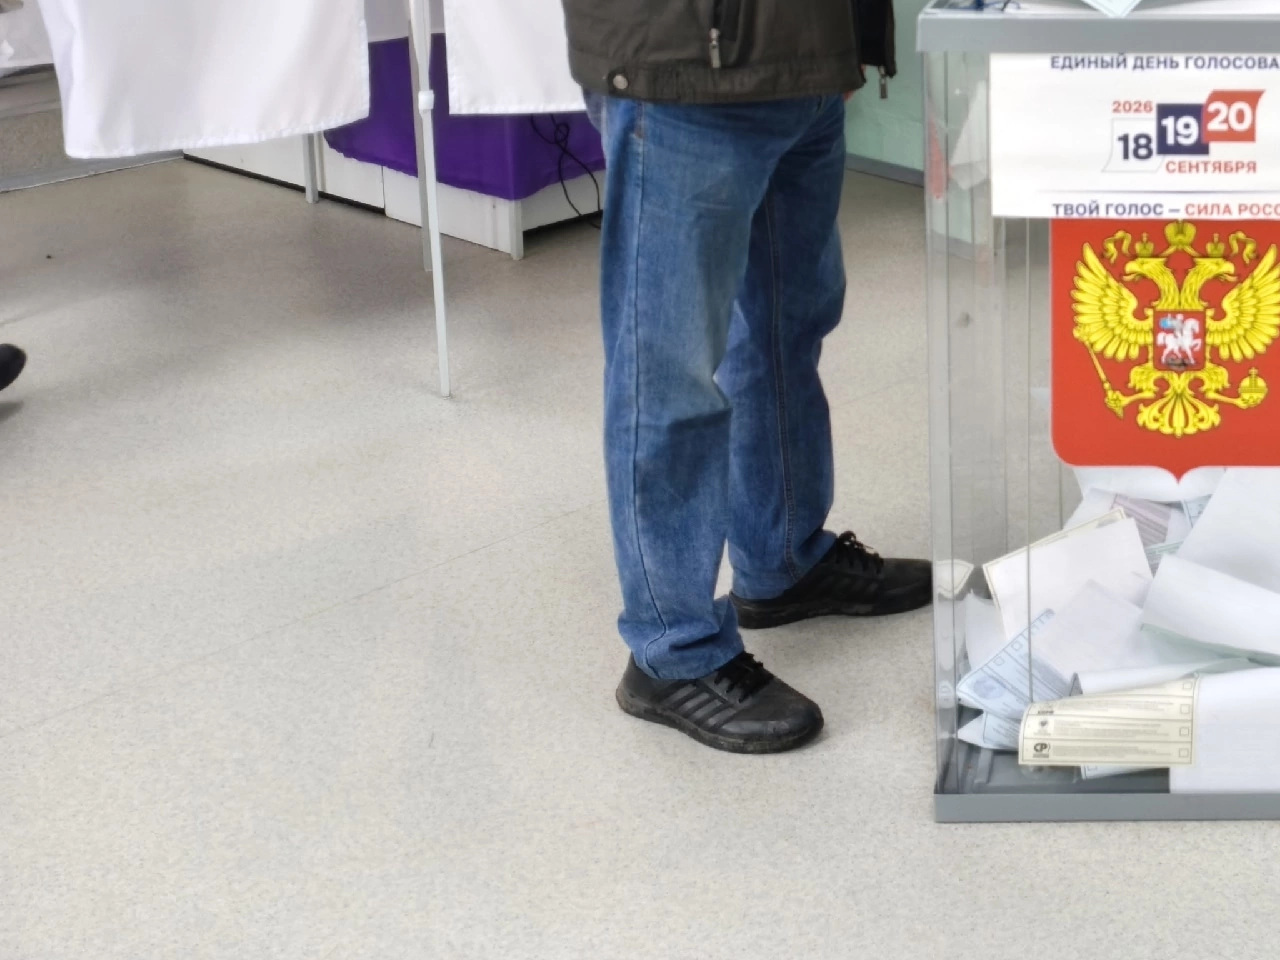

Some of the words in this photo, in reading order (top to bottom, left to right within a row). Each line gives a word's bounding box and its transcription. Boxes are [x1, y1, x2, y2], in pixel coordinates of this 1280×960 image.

[1051, 53, 1127, 70] ЕДИНЫЙ
[1132, 56, 1179, 70] ДЕНЬ
[1112, 101, 1153, 113] 2026
[1118, 133, 1153, 160] 18
[1161, 116, 1198, 146] 19
[1207, 102, 1253, 132] 20
[1166, 162, 1257, 174] СЕНТЯБРЯ
[1052, 200, 1100, 216] ТВОЙ
[1105, 203, 1164, 217] ГОЛОС
[1185, 203, 1232, 217] СИЛА
